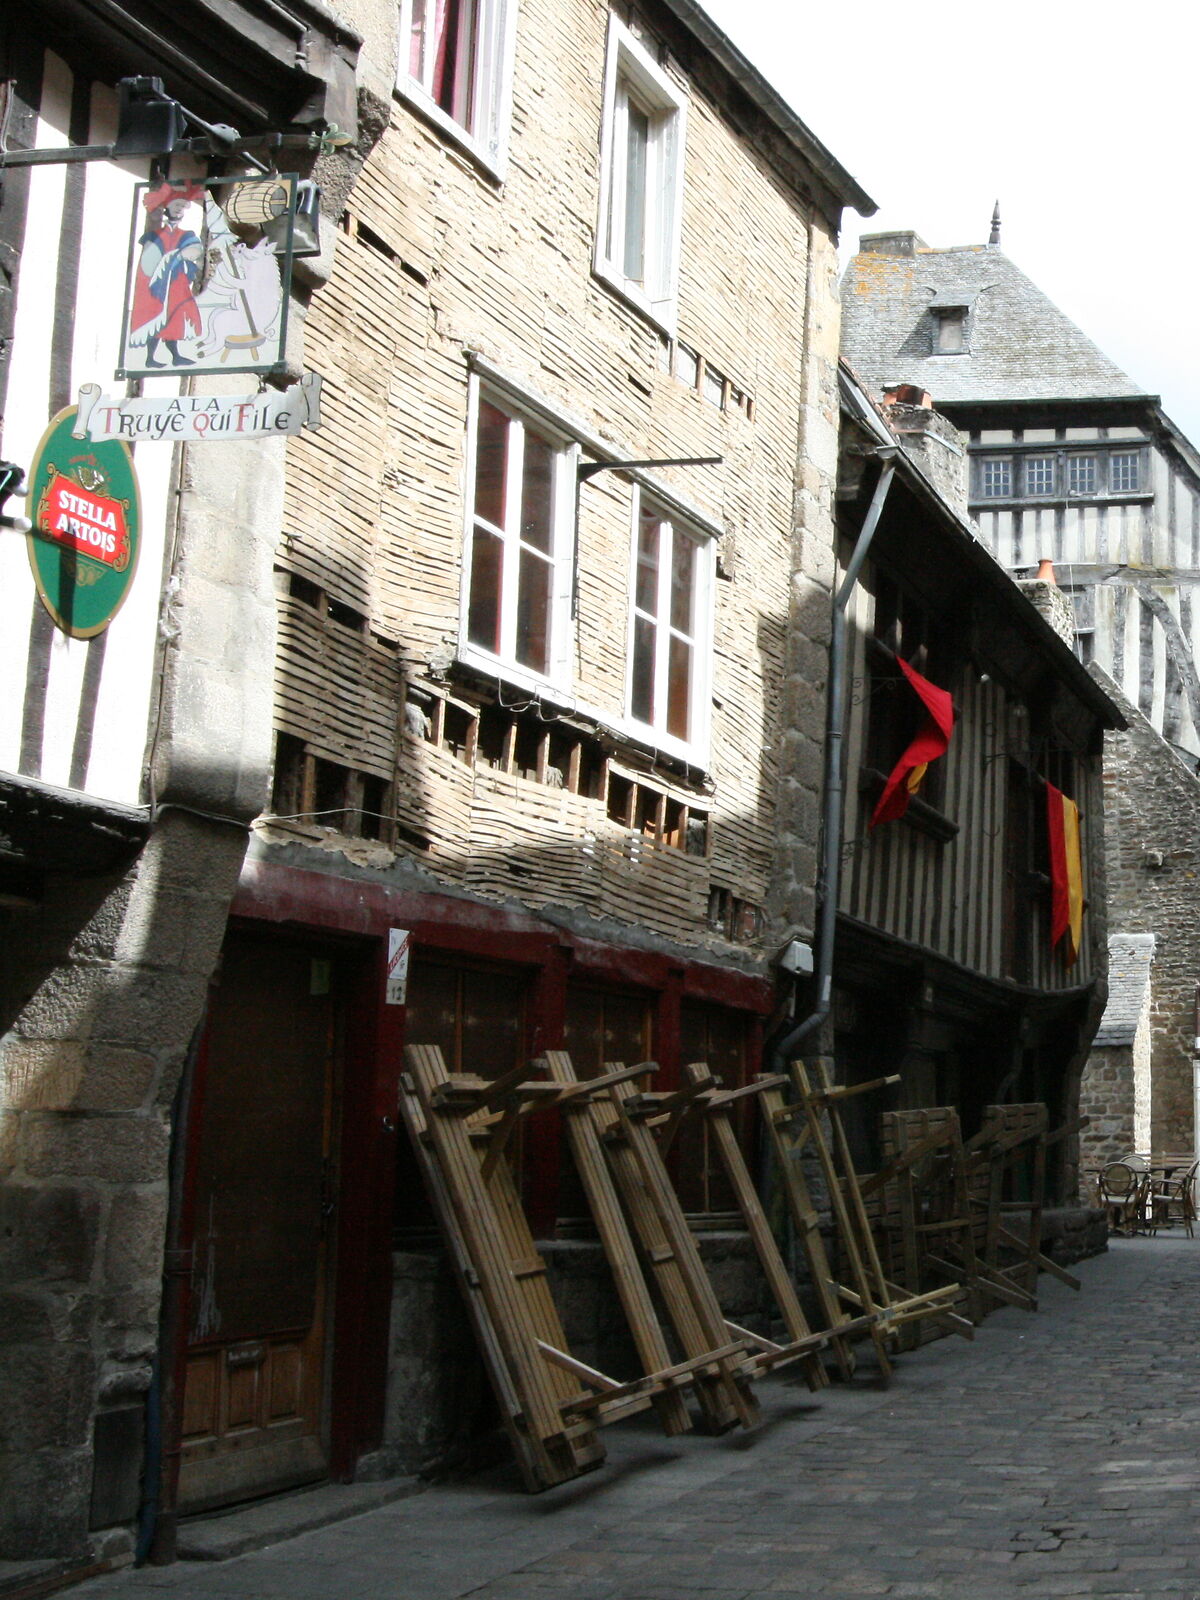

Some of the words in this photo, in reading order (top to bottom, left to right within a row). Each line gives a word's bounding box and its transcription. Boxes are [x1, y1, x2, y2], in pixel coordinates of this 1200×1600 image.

[167, 399, 182, 411] A
[191, 398, 220, 411] LA
[58, 490, 117, 531] STELLA
[56, 514, 116, 553] ARTOIS
